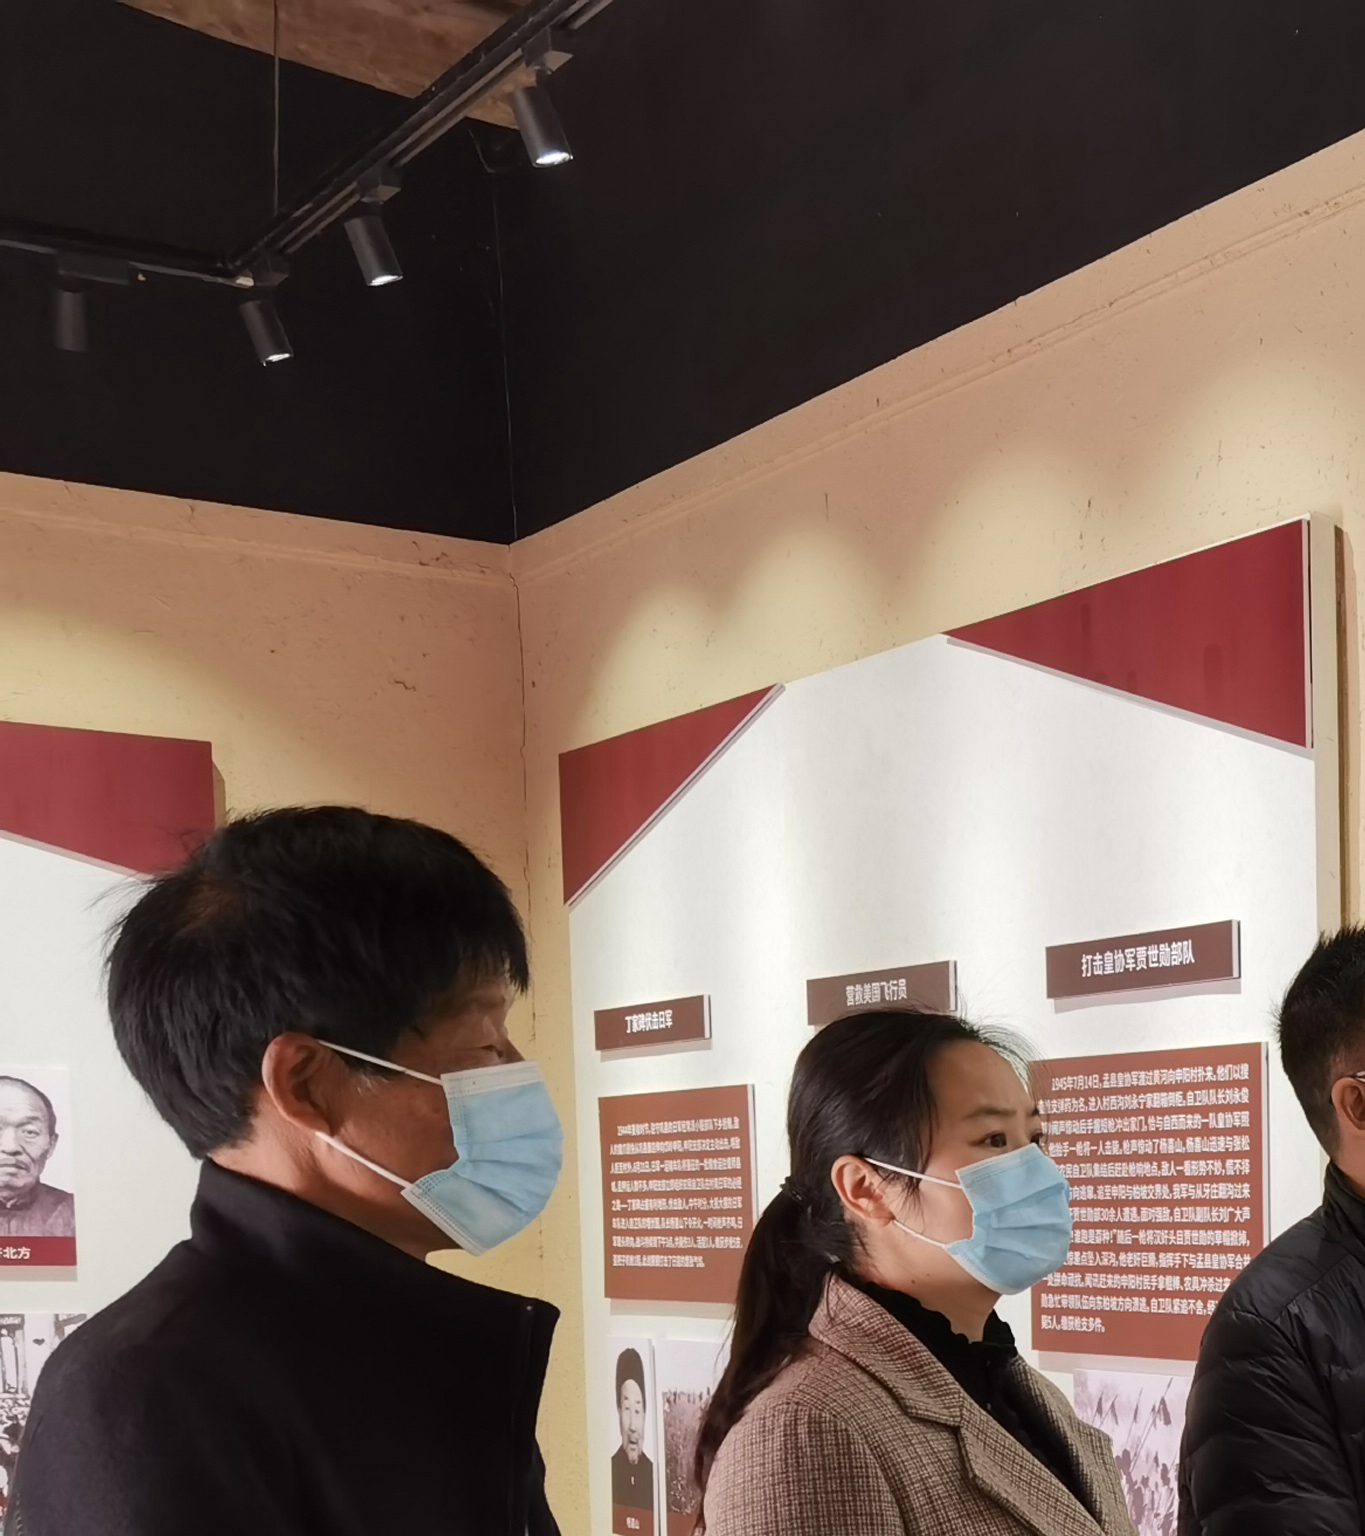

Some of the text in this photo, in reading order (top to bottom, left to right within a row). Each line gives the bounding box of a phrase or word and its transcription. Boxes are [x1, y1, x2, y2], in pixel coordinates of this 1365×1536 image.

[1081, 939, 1196, 979] 打击皇协军贾世勋部队
[845, 978, 907, 1006] 营救美国飞行员
